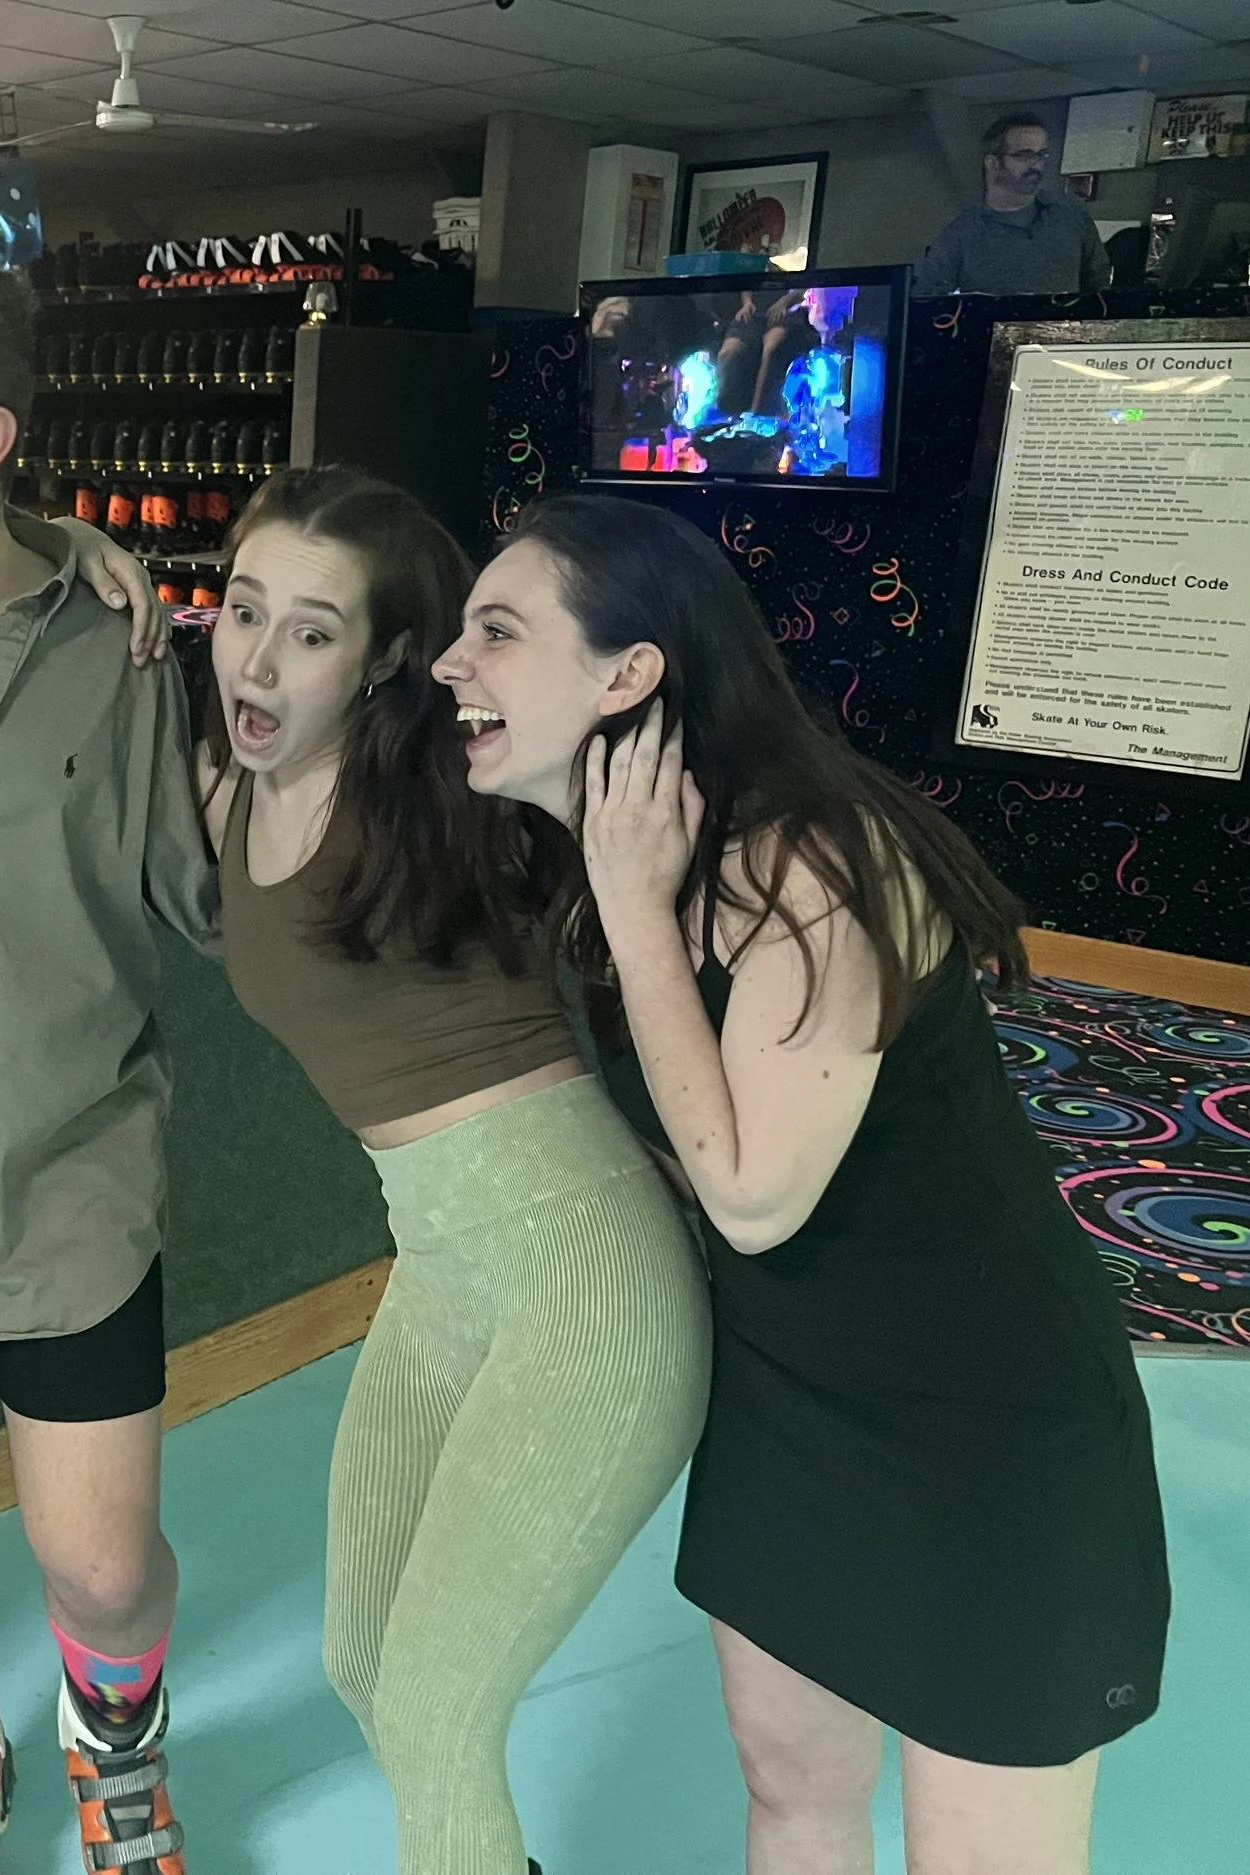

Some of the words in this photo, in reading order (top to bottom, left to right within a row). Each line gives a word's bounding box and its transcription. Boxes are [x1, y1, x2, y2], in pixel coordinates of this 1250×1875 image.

[1168, 113, 1203, 127] HELP
[1161, 126, 1196, 139] KEEP
[1085, 358, 1128, 371] Rules
[1136, 357, 1158, 370] Of
[1162, 357, 1233, 370] Conduct
[1022, 565, 1066, 579] Dress
[1072, 569, 1103, 582] And
[1110, 570, 1177, 587] Conduct
[1184, 575, 1229, 591] Code
[984, 680, 1011, 691] Please
[1013, 684, 1059, 694] understand
[1062, 686, 1078, 696] that
[1081, 689, 1104, 698] these
[1132, 694, 1152, 703] have
[1155, 696, 1177, 706] been
[1180, 699, 1232, 712] established
[984, 687, 999, 696] and
[1001, 689, 1014, 697] will
[1016, 690, 1027, 699] be
[1030, 692, 1068, 703] enforced
[1069, 694, 1081, 704] for
[1084, 697, 1098, 706] the
[1100, 699, 1127, 711] safety
[1130, 700, 1140, 710] of
[1142, 702, 1153, 712] all
[1031, 711, 1063, 725] Skate
[1067, 716, 1079, 727] At
[1084, 717, 1109, 729] Your
[1112, 720, 1137, 733] Own
[1127, 743, 1148, 754] The
[1152, 745, 1228, 764] Management
